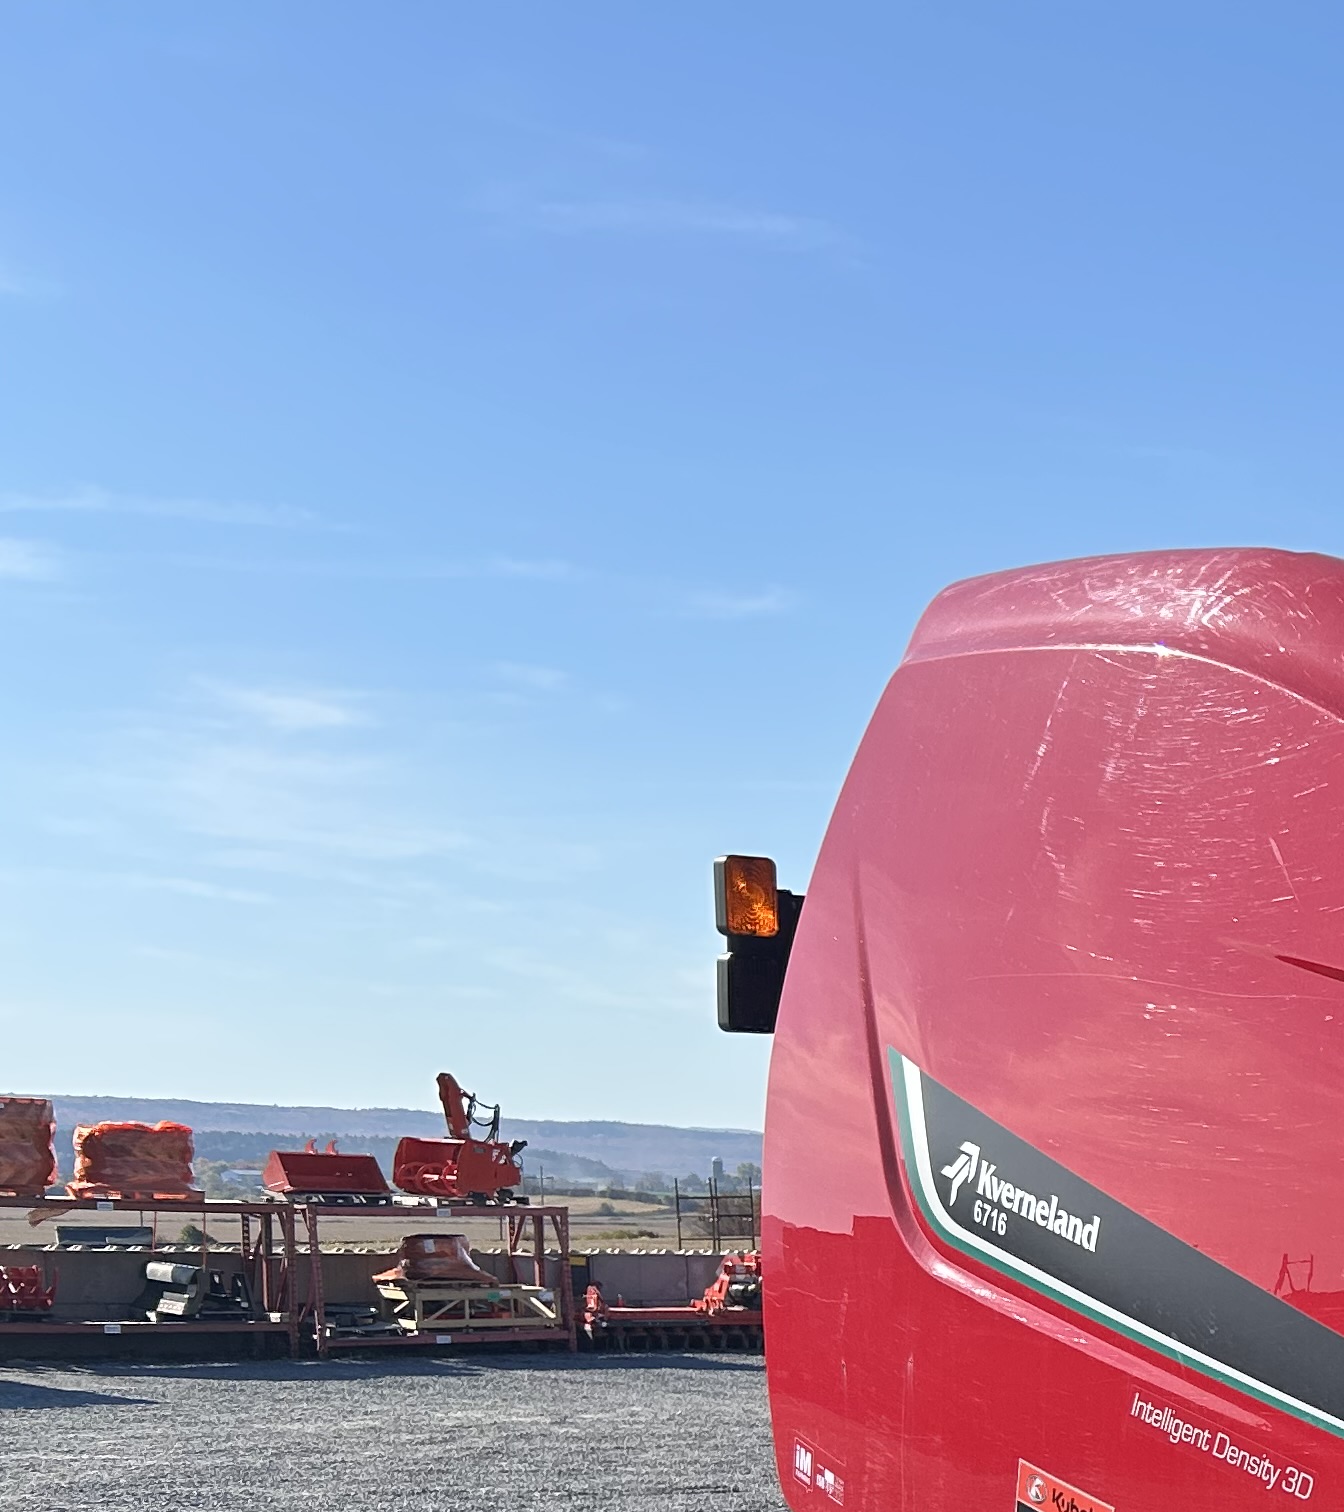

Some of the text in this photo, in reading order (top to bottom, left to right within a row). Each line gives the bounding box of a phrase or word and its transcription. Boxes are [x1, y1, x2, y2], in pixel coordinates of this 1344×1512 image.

[973, 1200, 1008, 1236] 6716
[976, 1159, 1101, 1253] Kverneland
[1130, 1391, 1315, 1502] Intelligent Density 3D
